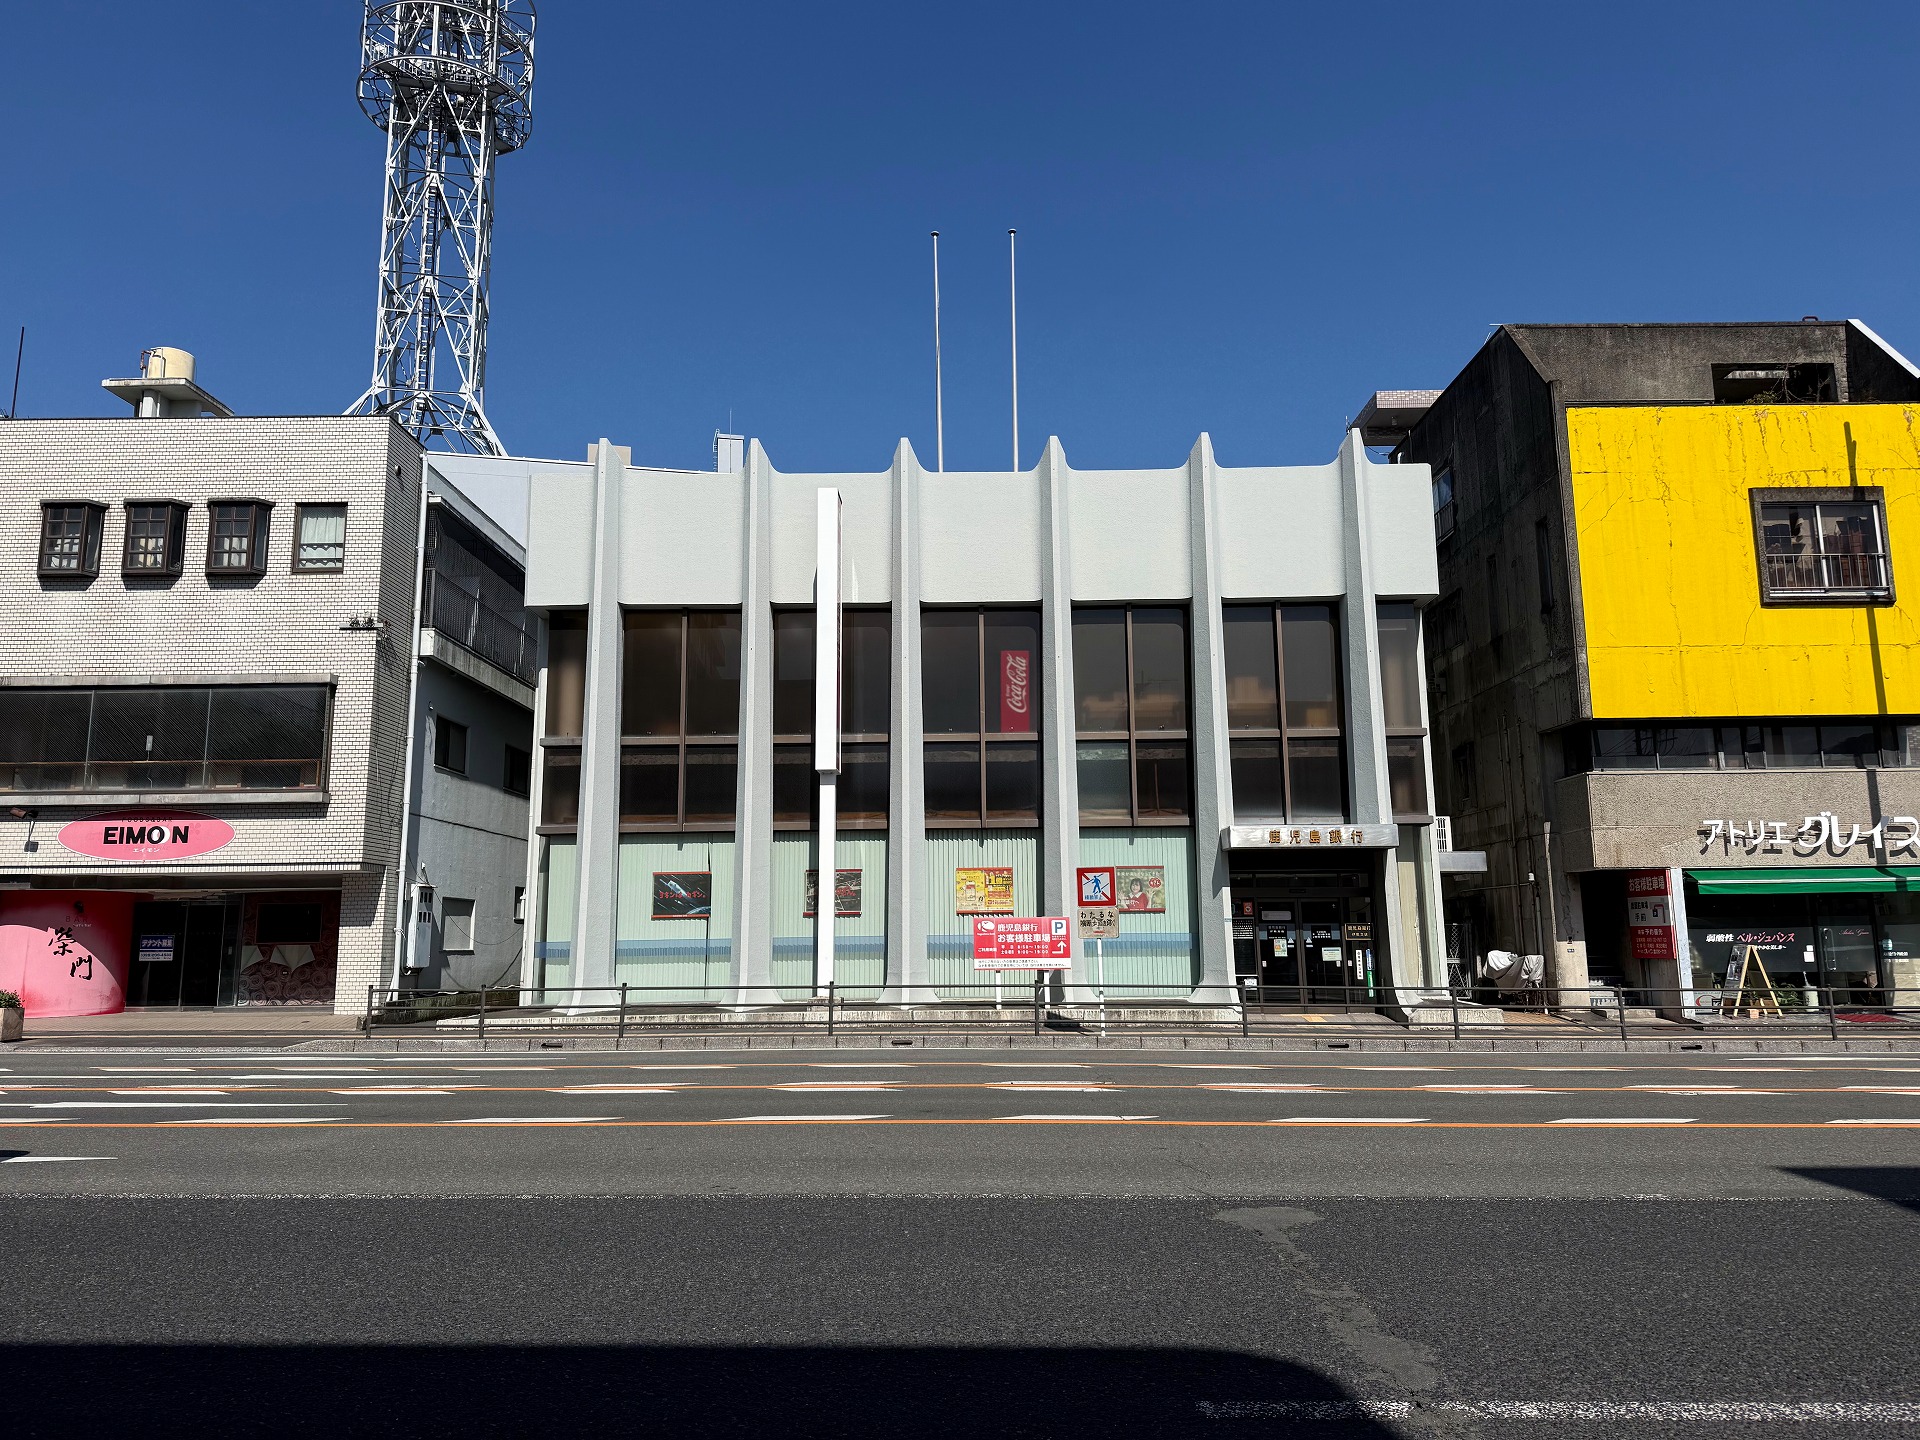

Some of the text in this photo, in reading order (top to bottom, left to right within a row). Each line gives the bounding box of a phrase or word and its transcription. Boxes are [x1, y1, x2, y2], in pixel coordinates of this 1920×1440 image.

[1006, 653, 1027, 714] Coca-Cola
[103, 825, 190, 845] EIMON
[1268, 829, 1364, 844] 鹿児島銀行
[1702, 811, 1920, 849] アトリエ グレイス
[1080, 910, 1114, 919] わたるな
[997, 923, 1039, 932] 鹿児島銀行
[1054, 921, 1064, 933] P
[997, 933, 1051, 943] お客様駐車場
